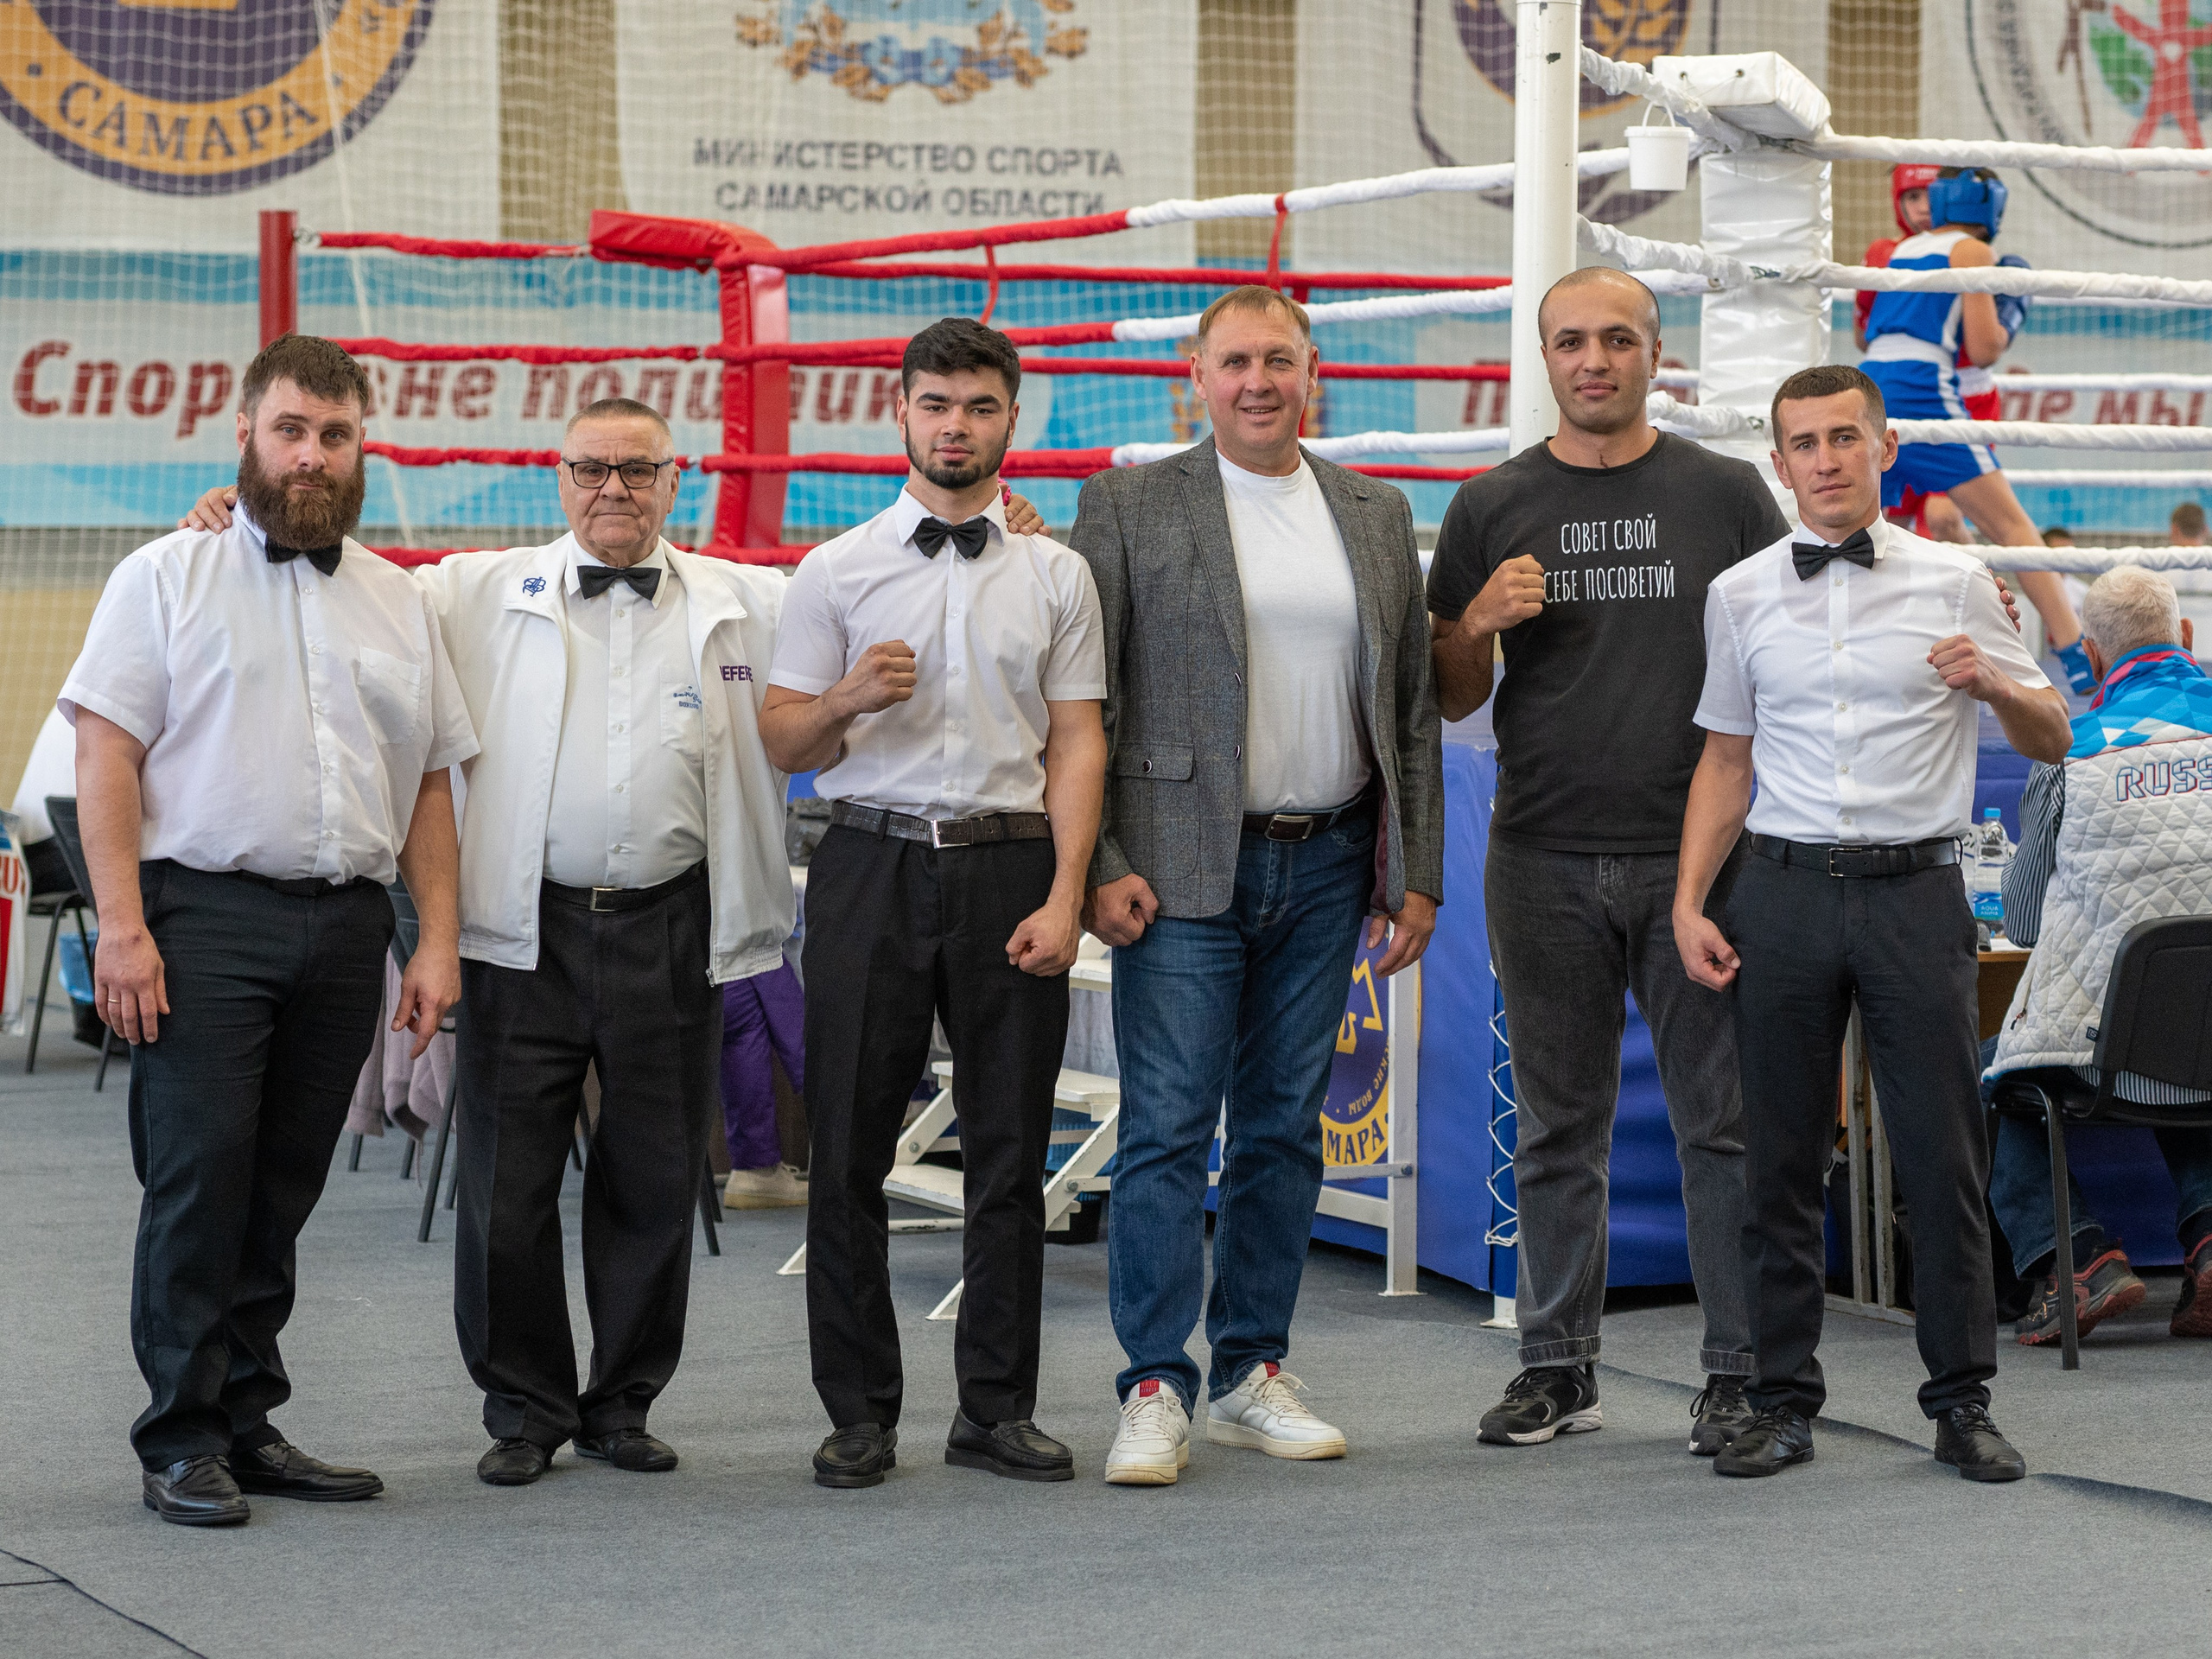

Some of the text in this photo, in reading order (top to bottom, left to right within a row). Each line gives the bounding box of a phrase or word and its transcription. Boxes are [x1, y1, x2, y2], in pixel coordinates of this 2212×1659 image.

[58, 80, 318, 162] САМАРА
[694, 137, 1125, 177] МИНИСТЕРСТВО СПОРТА
[715, 178, 1104, 217] САМАРСКОЙ ОБЛАСТИ
[1560, 513, 1656, 554] СОВЕТ СВОЙ
[1543, 559, 1675, 603] СЕБЕ ПОСОВЕТУЙ
[1326, 1117, 1385, 1165] МАРА
